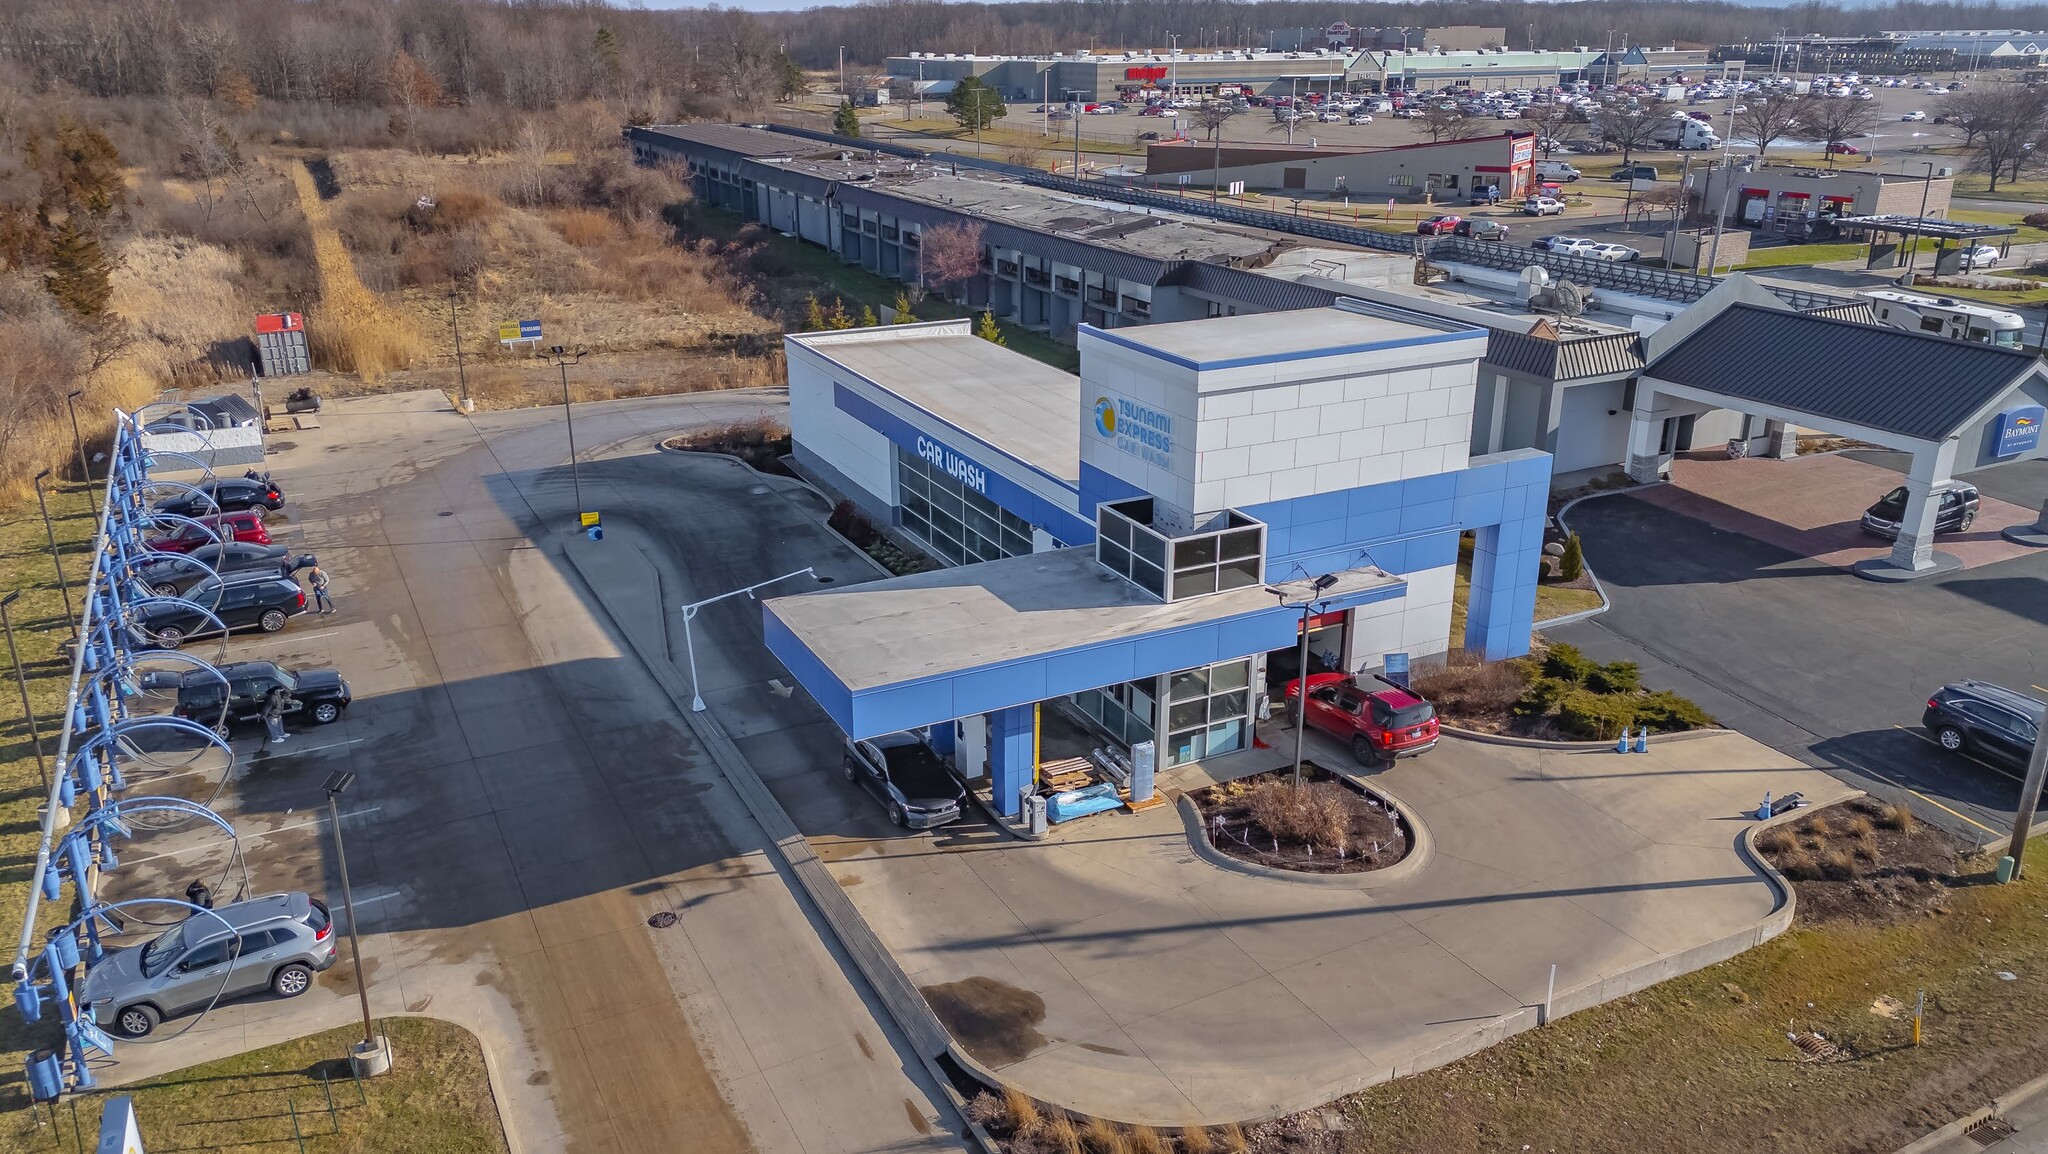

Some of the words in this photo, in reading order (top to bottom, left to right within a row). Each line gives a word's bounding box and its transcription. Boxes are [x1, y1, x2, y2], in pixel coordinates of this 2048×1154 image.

[1118, 398, 1171, 434] TSUNAMI
[2004, 424, 2039, 438] BAYMONT
[1117, 417, 1170, 453] EXPRESS
[917, 435, 943, 469] CAR
[945, 451, 986, 494] WASH
